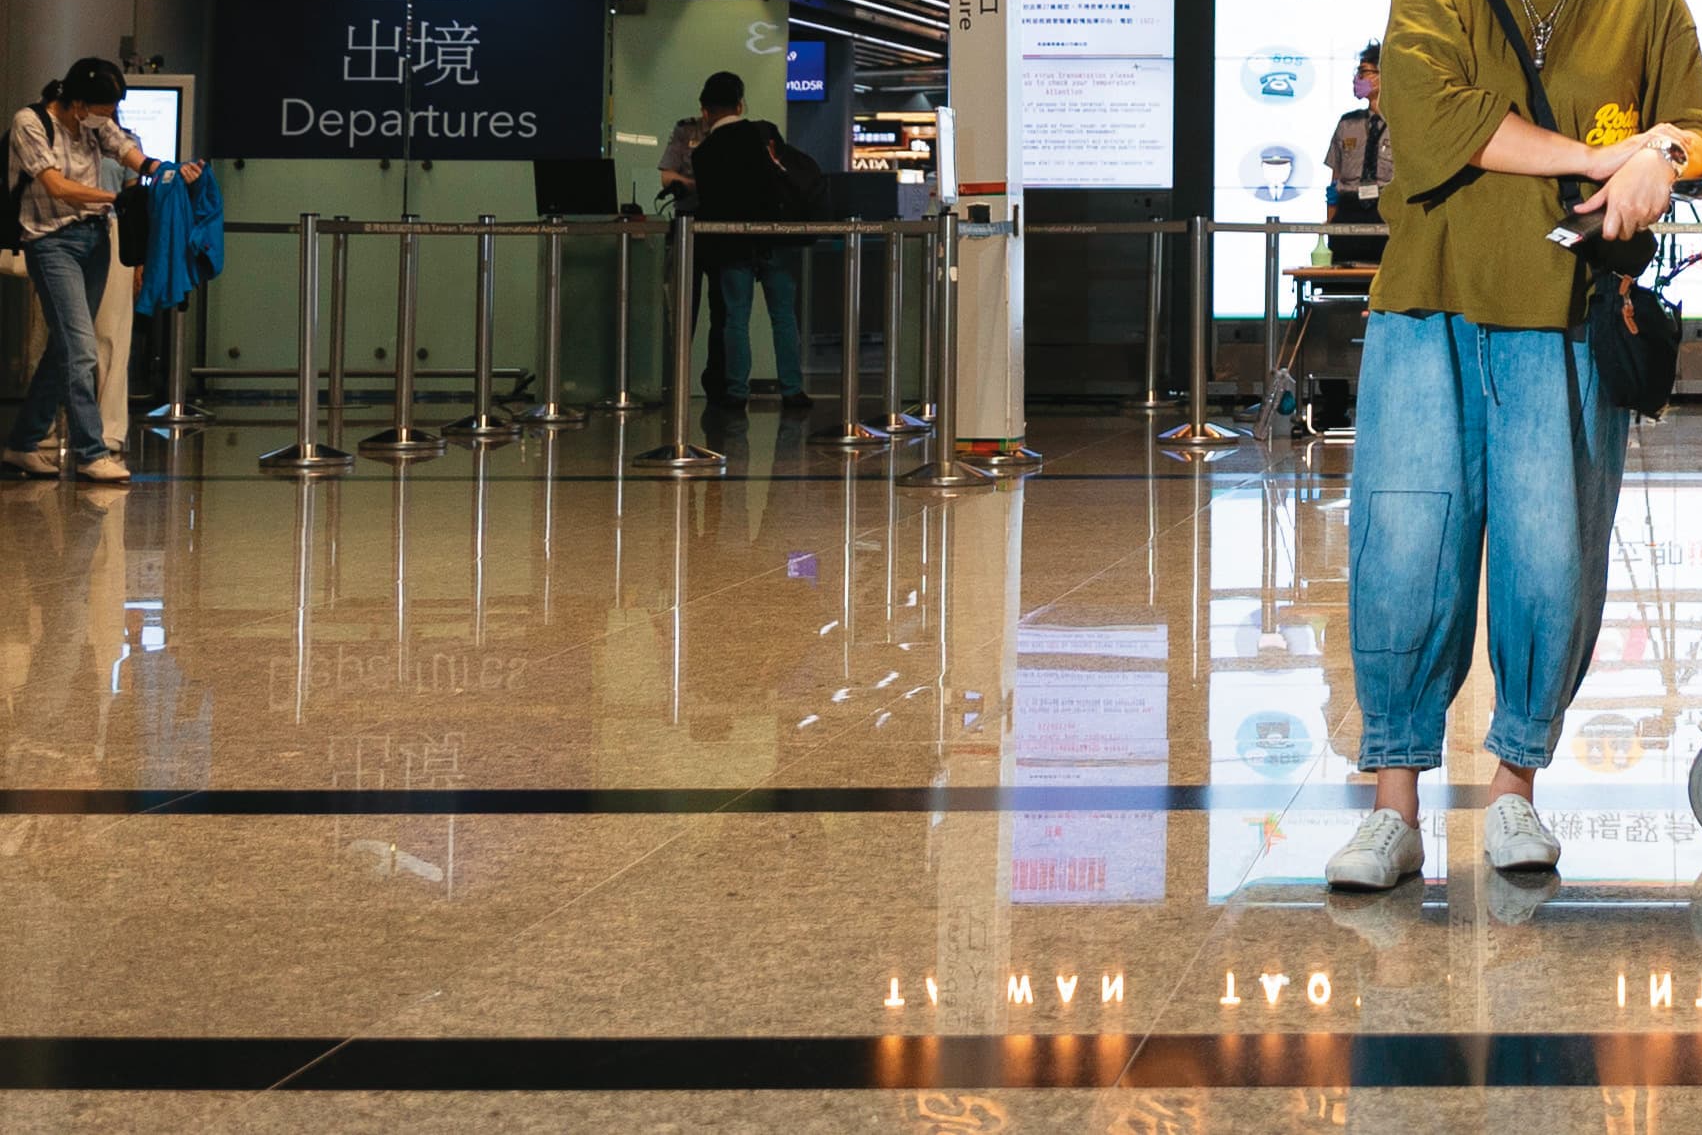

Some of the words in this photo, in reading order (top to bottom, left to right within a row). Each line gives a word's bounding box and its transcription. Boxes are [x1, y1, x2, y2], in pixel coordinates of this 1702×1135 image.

[341, 18, 480, 87] 出境
[280, 97, 538, 148] Departures
[432, 224, 455, 234] Taiwan
[457, 224, 490, 236] Taoyuan
[492, 224, 541, 235] International
[543, 224, 568, 237] Airport
